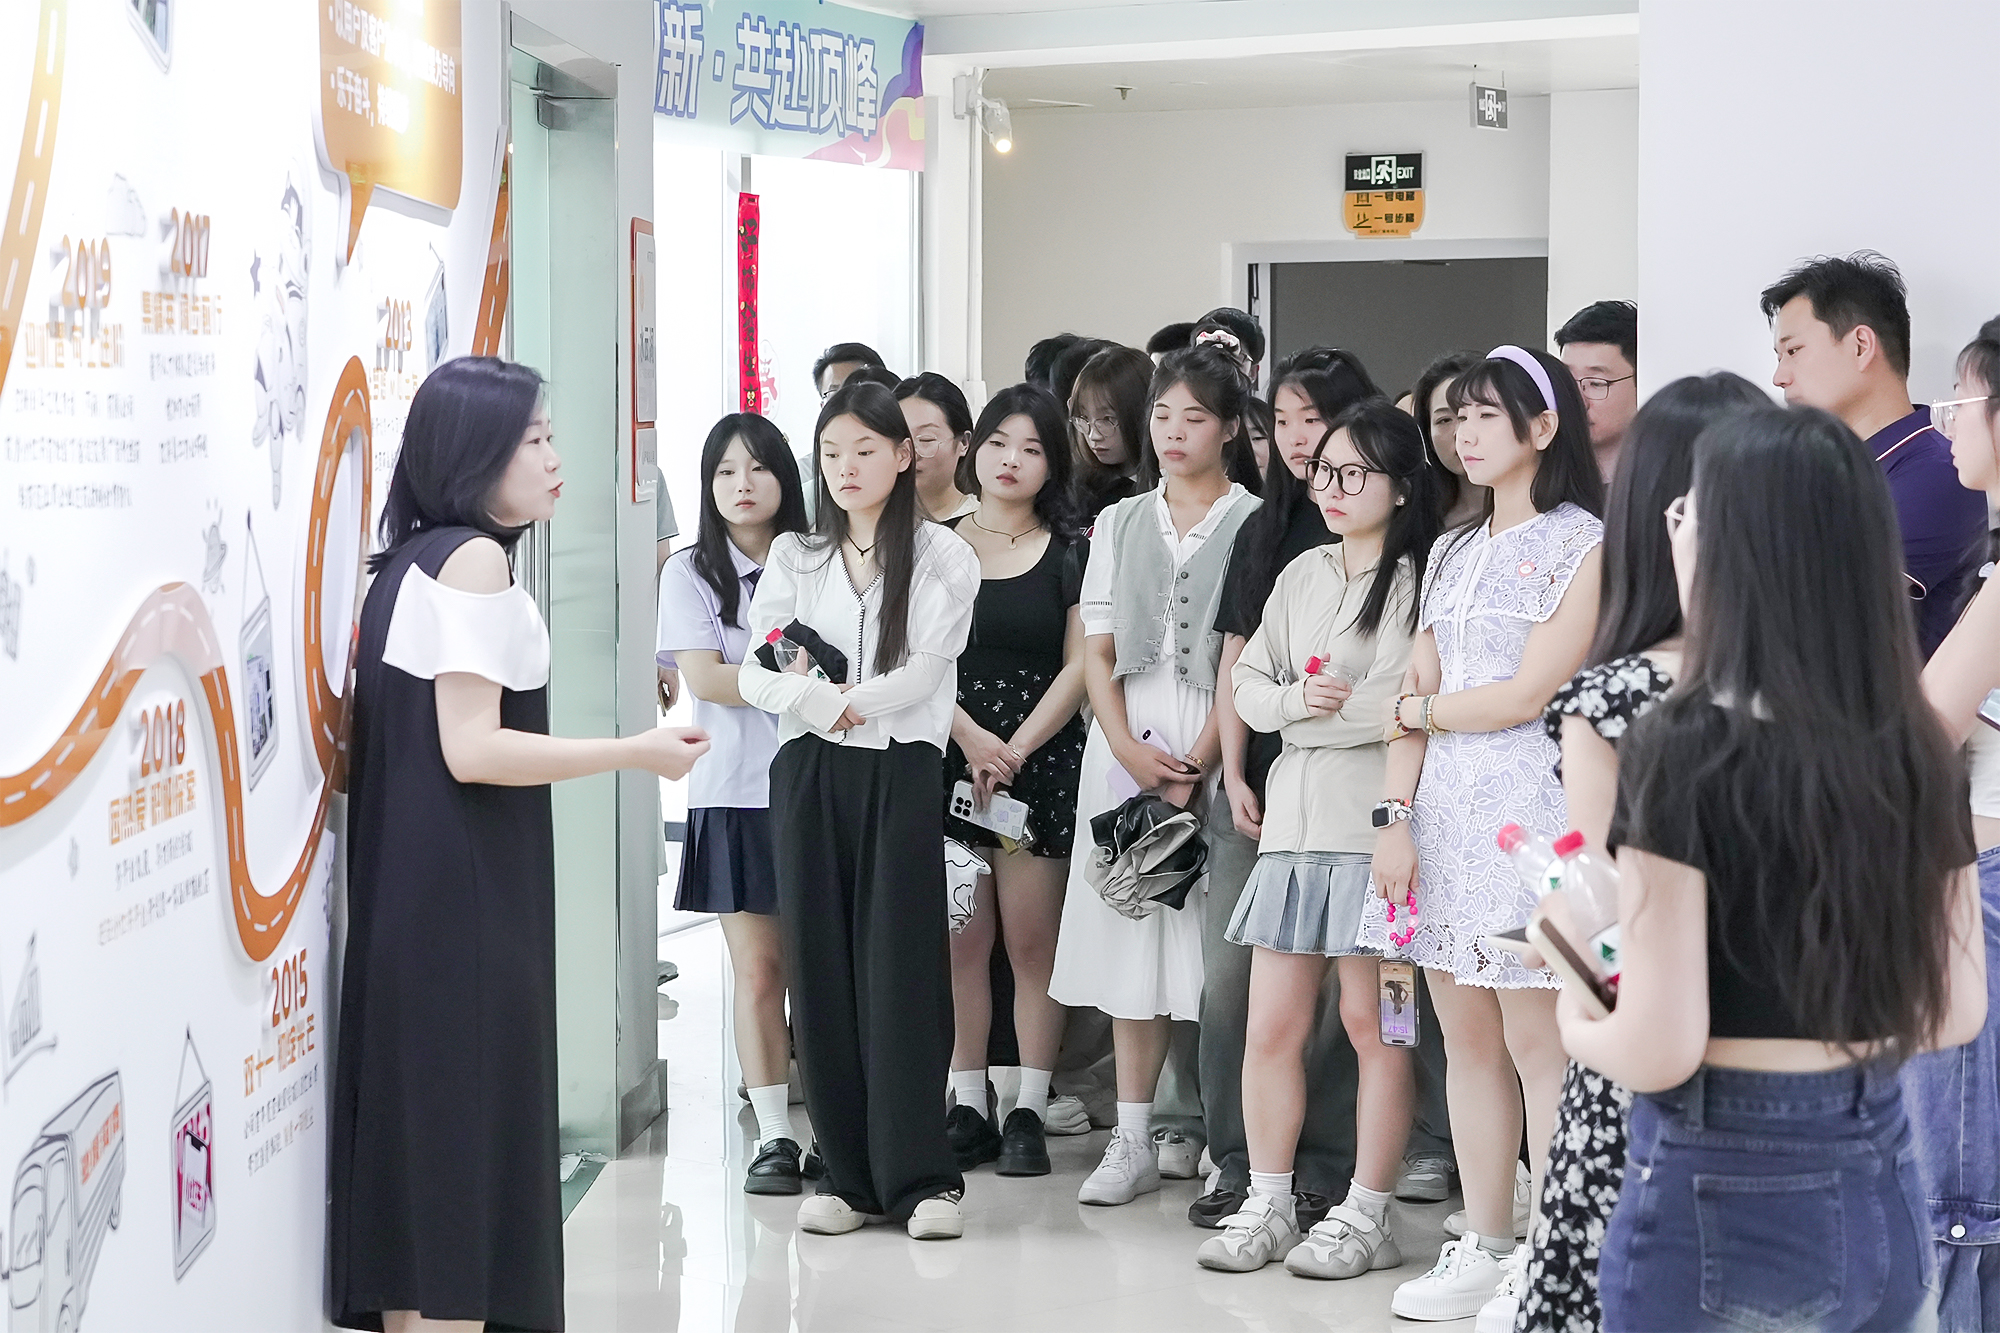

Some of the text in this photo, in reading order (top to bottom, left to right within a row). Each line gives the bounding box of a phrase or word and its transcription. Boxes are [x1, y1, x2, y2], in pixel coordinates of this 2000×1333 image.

[652, 0, 878, 141] 新·共赴顶峰
[1396, 166, 1415, 179] EXIT
[62, 234, 111, 311] 2019
[170, 206, 210, 278] 2017
[385, 296, 412, 351] 2013
[140, 698, 187, 778] 2018
[271, 948, 308, 1027] 2015
[1388, 1025, 1408, 1034] 15:47
